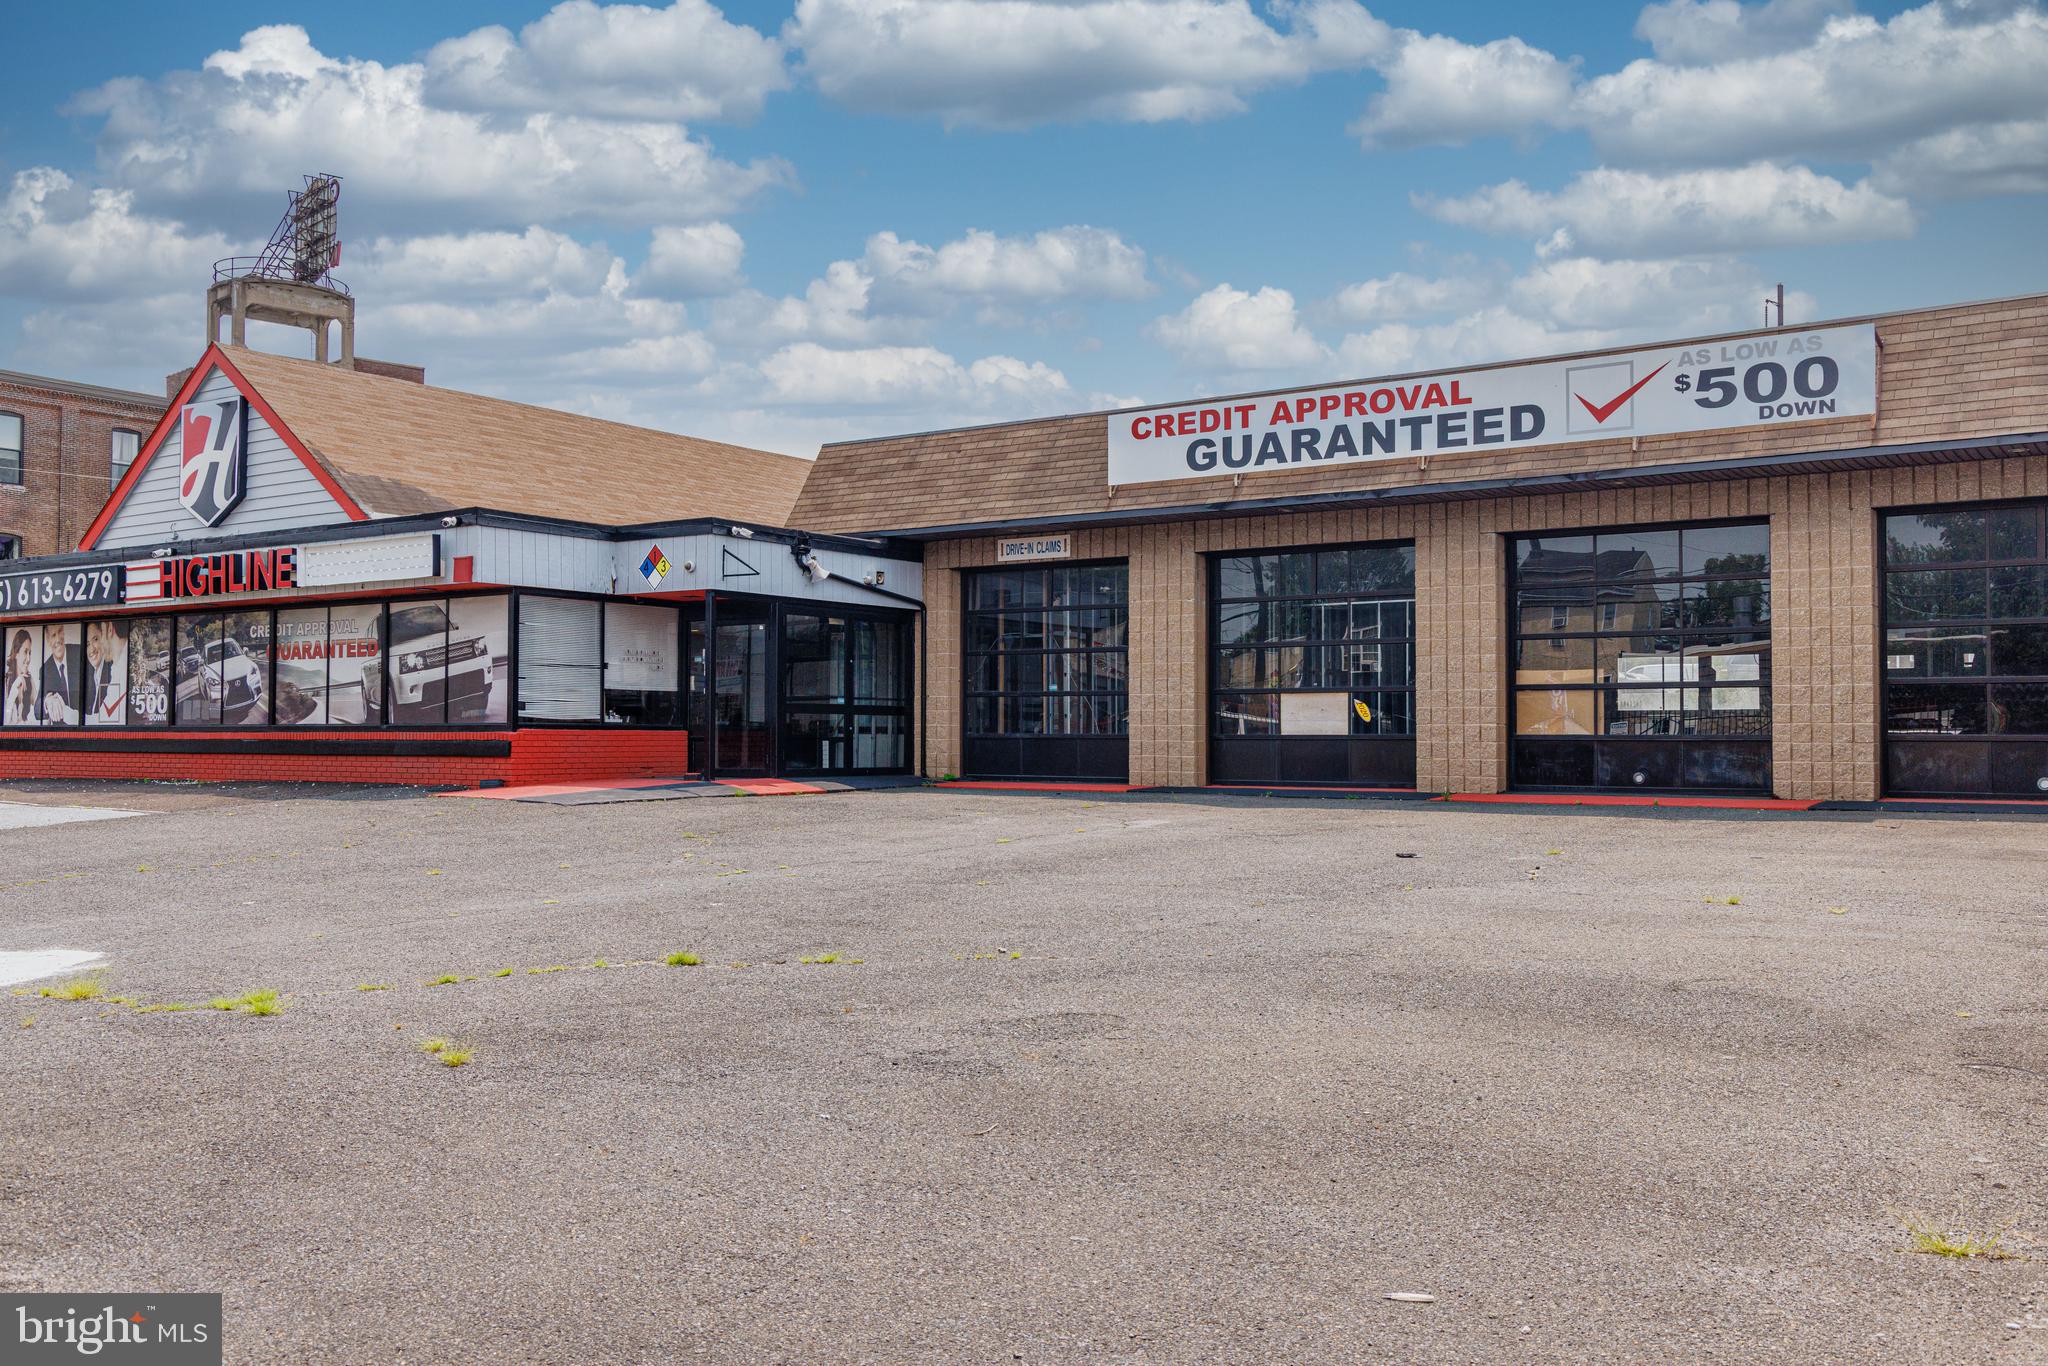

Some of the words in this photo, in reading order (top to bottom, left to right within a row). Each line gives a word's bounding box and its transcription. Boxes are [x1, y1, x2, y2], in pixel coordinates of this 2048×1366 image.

[1678, 349, 1711, 367] AS
[1721, 340, 1778, 362] LOW
[1787, 335, 1823, 355] AS
[1674, 356, 1839, 408] $500
[1131, 404, 1256, 440] CREDIT
[1269, 380, 1472, 426] APPROVAL
[1759, 399, 1836, 420] DOWN
[1186, 404, 1545, 472] GUARANTEED
[1006, 542, 1033, 556] DRIVE-IN
[1037, 540, 1061, 553] CLAIMS
[160, 548, 294, 598] HIGHLINE
[643, 562, 649, 573] 4
[661, 560, 666, 572] 3
[18, 569, 112, 606] 613-6279
[296, 619, 359, 637] APPROVAL
[132, 686, 140, 694] AS
[156, 685, 165, 693] AS
[130, 693, 168, 714] $500
[149, 713, 167, 721] DOWN
